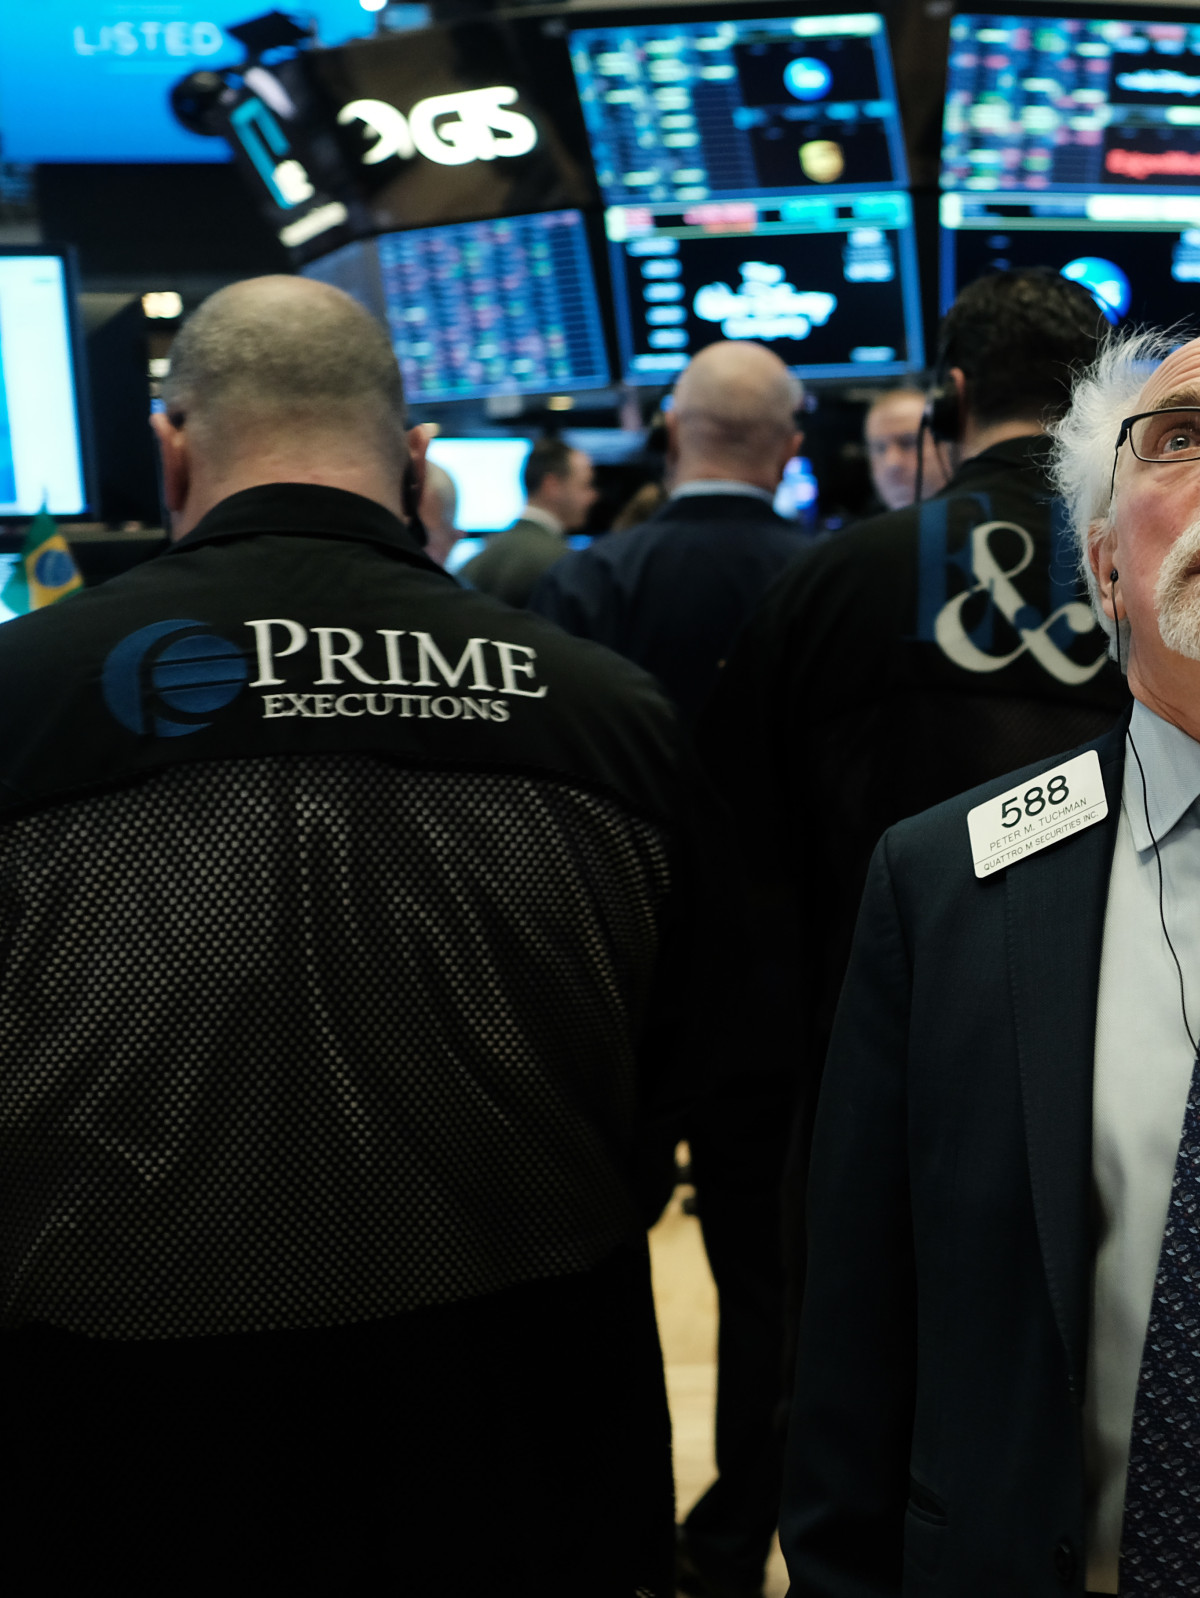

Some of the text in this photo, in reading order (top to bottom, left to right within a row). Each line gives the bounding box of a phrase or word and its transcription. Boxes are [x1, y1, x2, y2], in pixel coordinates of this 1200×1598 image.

[73, 21, 223, 56] LISTED
[244, 618, 549, 698] PRIME
[261, 693, 511, 722] EXECUTIONS
[989, 797, 1088, 851] PETER M. TUCHMAN
[1001, 774, 1070, 829] 588
[983, 810, 1099, 871] QUATTRO M SECURITIES INC.
